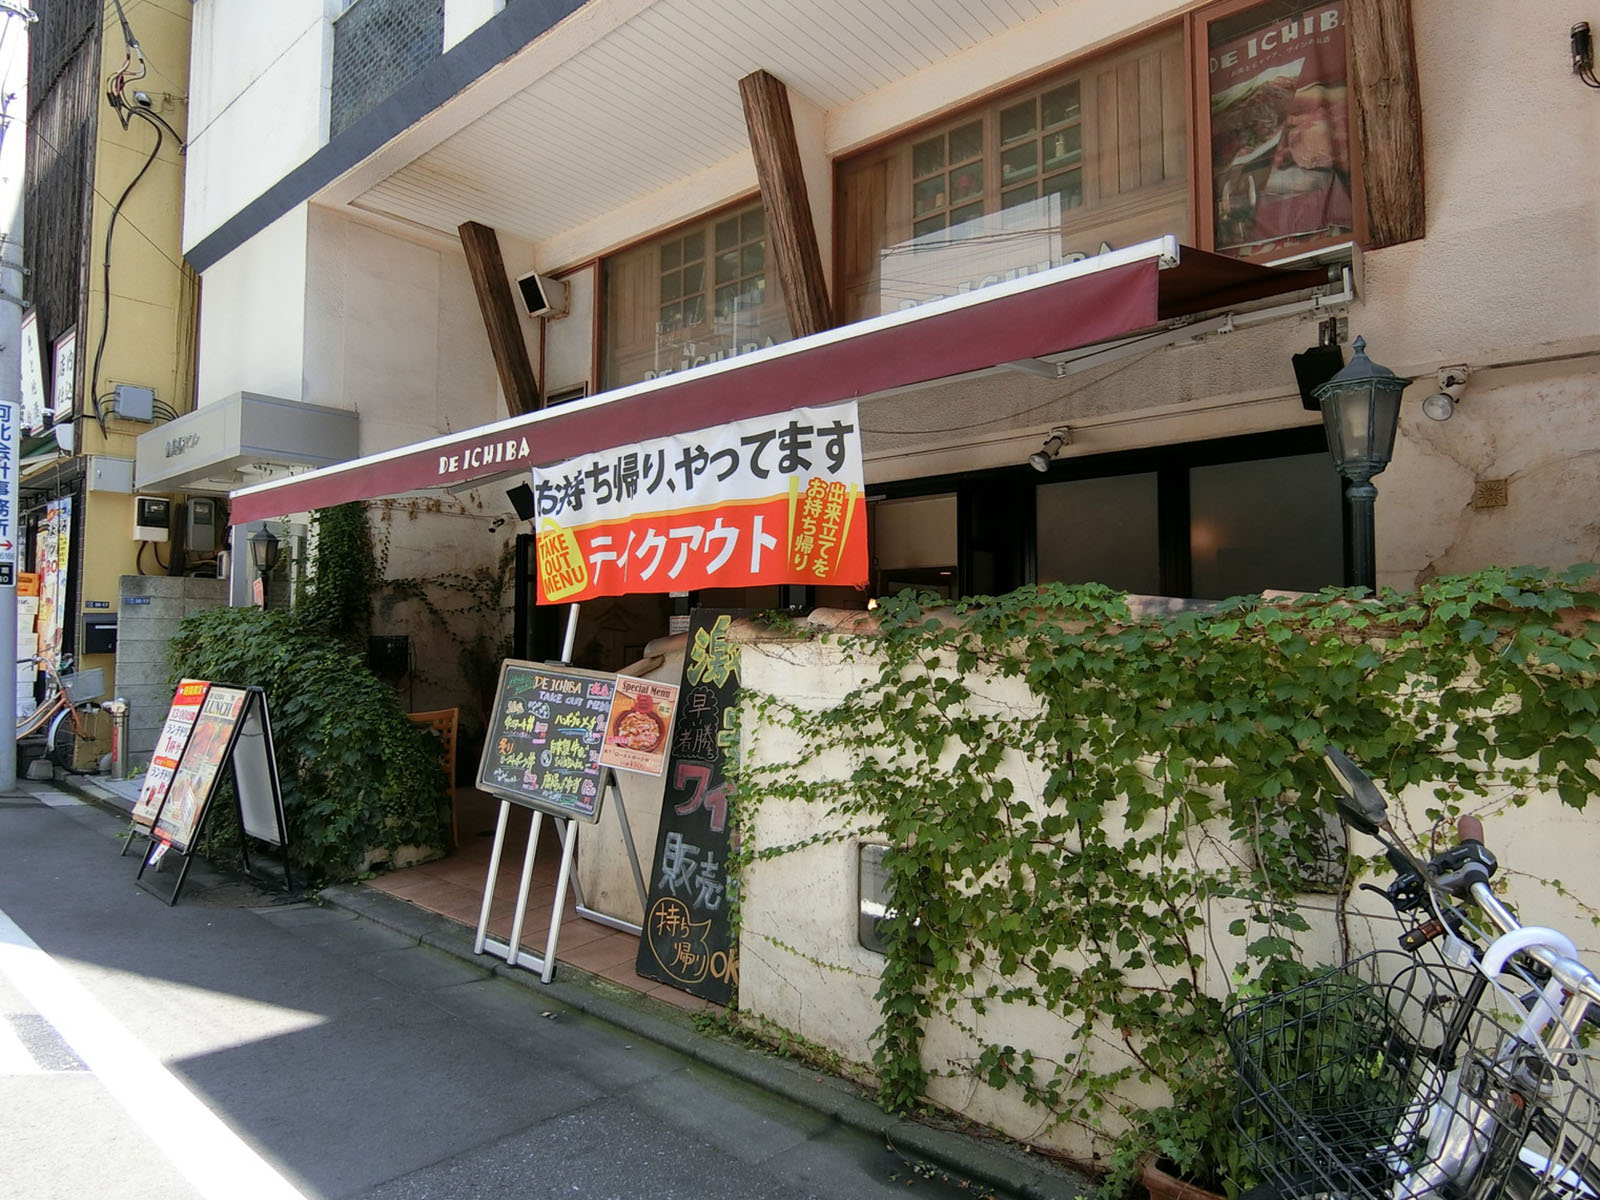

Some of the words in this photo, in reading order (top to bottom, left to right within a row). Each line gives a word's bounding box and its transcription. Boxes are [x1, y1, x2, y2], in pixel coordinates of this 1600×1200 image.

[1247, 9, 1346, 59] ICHIB
[438, 456, 459, 475] DE
[462, 436, 531, 471] ICHIBA
[535, 420, 854, 516] お持ち帰り、やってます
[793, 477, 828, 573] お持ち帰り
[813, 482, 845, 578] 出来立てを
[539, 532, 568, 558] TAKE
[544, 552, 571, 577] OUT
[543, 568, 585, 594] MENU
[538, 690, 563, 704] TAKE
[622, 681, 649, 694] Special
[650, 686, 671, 698] Menu
[204, 699, 233, 717] LUNCH
